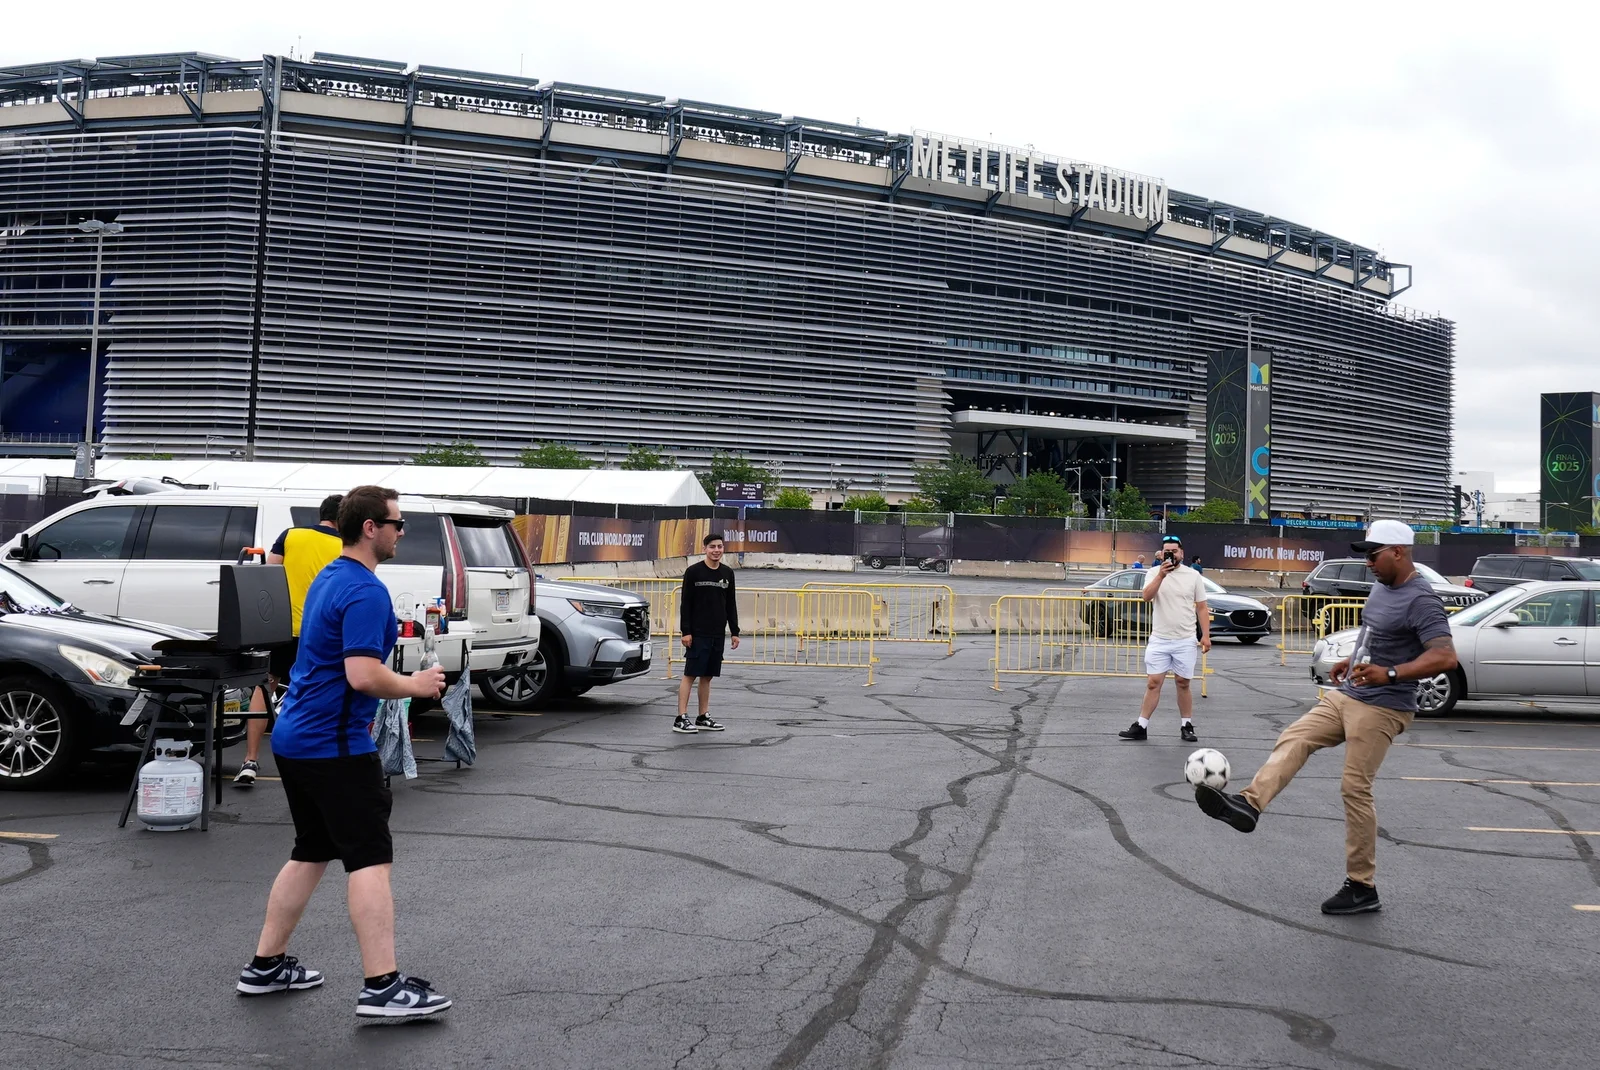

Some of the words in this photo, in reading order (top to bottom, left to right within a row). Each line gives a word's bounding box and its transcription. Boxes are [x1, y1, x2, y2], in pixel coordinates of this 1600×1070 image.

[911, 135, 1044, 199] METLIFE
[1056, 162, 1168, 224] STADIUM
[1250, 384, 1269, 392] MetLife
[1218, 424, 1234, 432] FINAL
[1215, 432, 1236, 445] 2025
[1552, 461, 1579, 472] 2025
[579, 532, 591, 546] FIFA
[591, 532, 603, 546] CLUB
[604, 533, 622, 546] WORLD
[622, 534, 632, 546] CUP
[748, 530, 778, 543] World
[1224, 545, 1247, 558] New
[1250, 546, 1274, 559] York
[1277, 547, 1297, 560] New
[1297, 548, 1325, 562] Jersey
